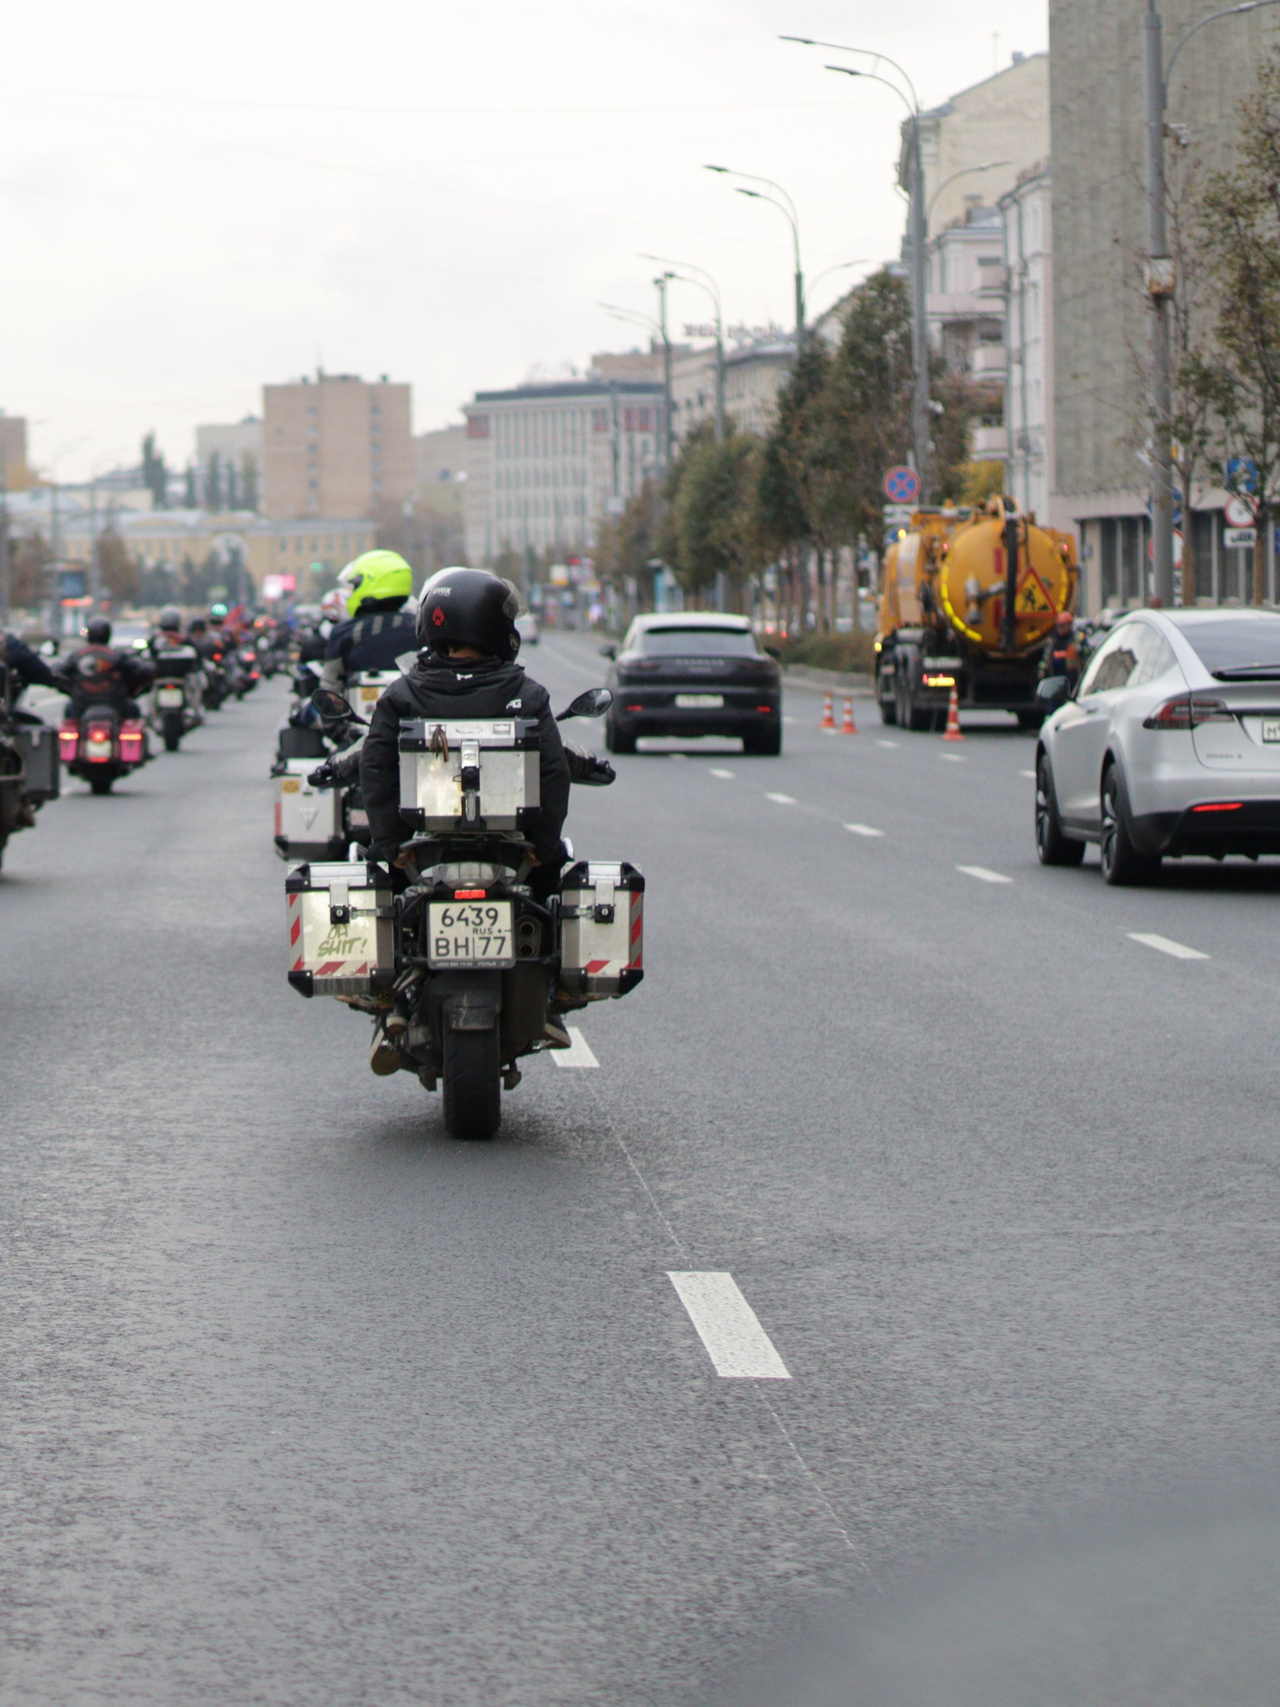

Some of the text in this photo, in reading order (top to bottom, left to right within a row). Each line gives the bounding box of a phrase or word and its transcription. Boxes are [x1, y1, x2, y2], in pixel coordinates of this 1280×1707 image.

[441, 907, 499, 927] 6439
[472, 927, 493, 935] RUS
[317, 933, 368, 958] SHIT!
[435, 936, 506, 957] BH 77
